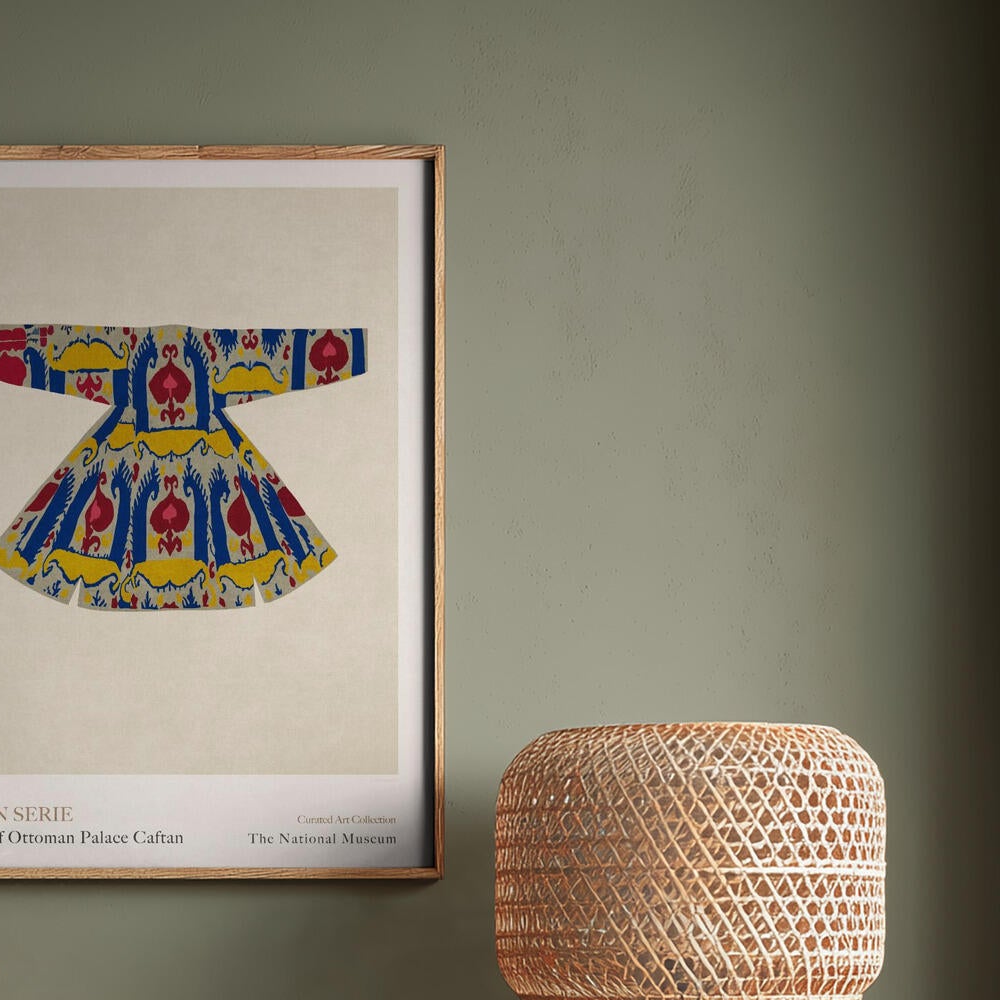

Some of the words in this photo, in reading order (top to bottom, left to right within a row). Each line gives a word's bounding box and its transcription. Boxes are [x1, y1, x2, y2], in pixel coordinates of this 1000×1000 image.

[12, 806, 73, 823] SERIE
[297, 814, 333, 825] Curated
[335, 814, 350, 825] Art
[351, 814, 397, 825] Collection
[8, 830, 75, 845] Ottoman
[80, 830, 129, 845] Palace
[133, 830, 184, 845] Caftan
[248, 832, 274, 845] The
[279, 832, 336, 845] National
[342, 832, 397, 845] Museum
